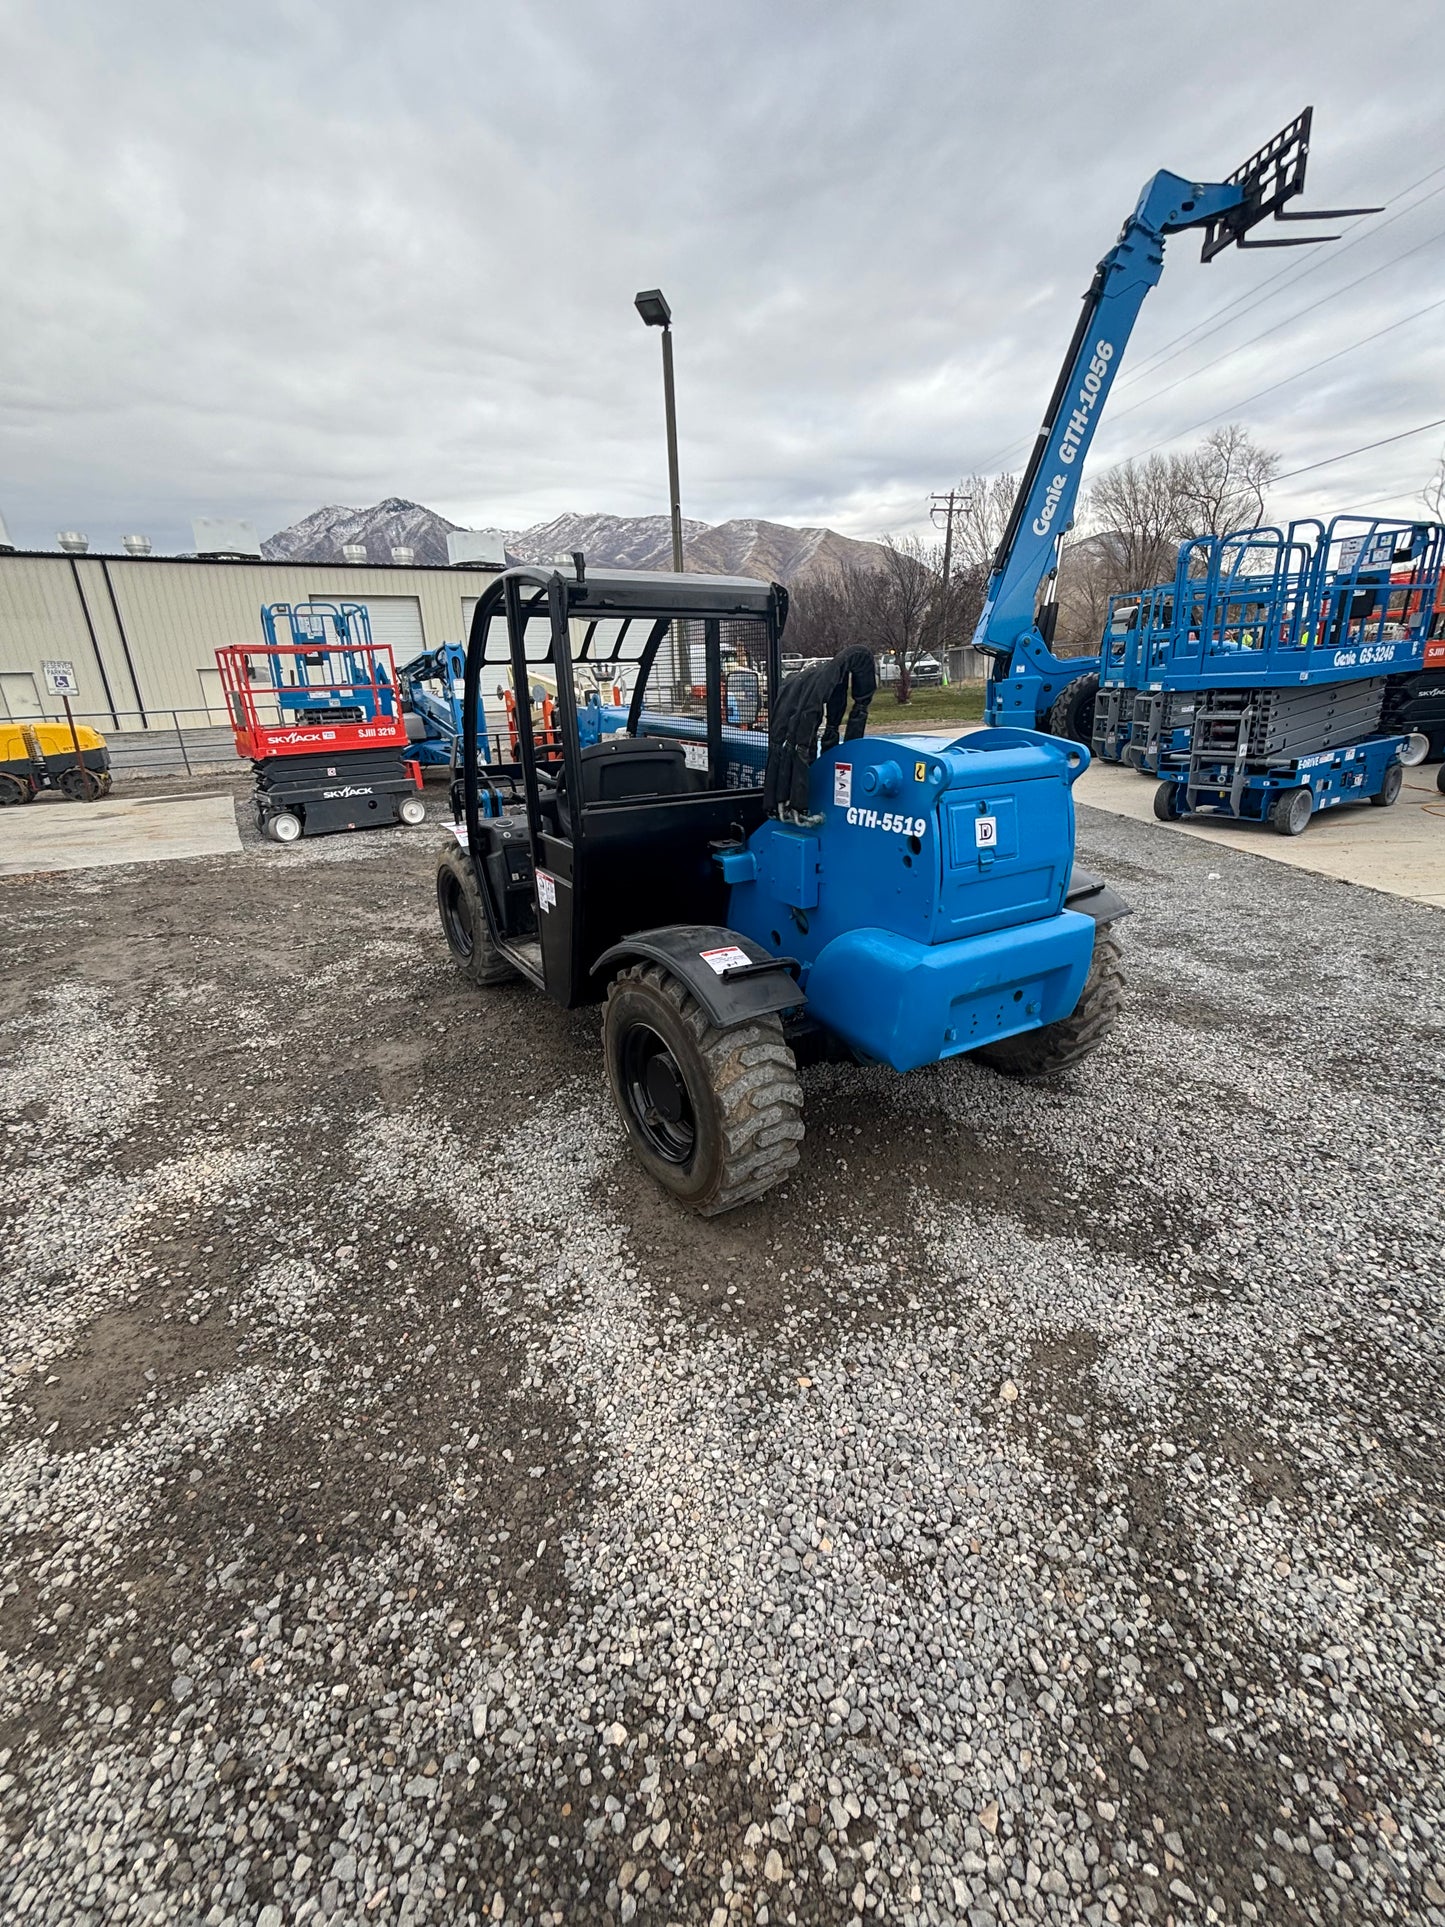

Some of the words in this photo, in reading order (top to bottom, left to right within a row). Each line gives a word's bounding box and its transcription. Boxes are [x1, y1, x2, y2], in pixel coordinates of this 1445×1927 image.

[1032, 474, 1066, 536] Genie
[1058, 339, 1114, 464] GTH-1056
[1334, 650, 1357, 667] Genie
[1360, 645, 1395, 664] GS-3246
[267, 732, 322, 744] SKYJACK
[377, 727, 396, 737] 3219
[1297, 756, 1320, 771] E-DRIVE
[323, 786, 373, 799] SKYJACK
[846, 807, 926, 838] GTH-5519
